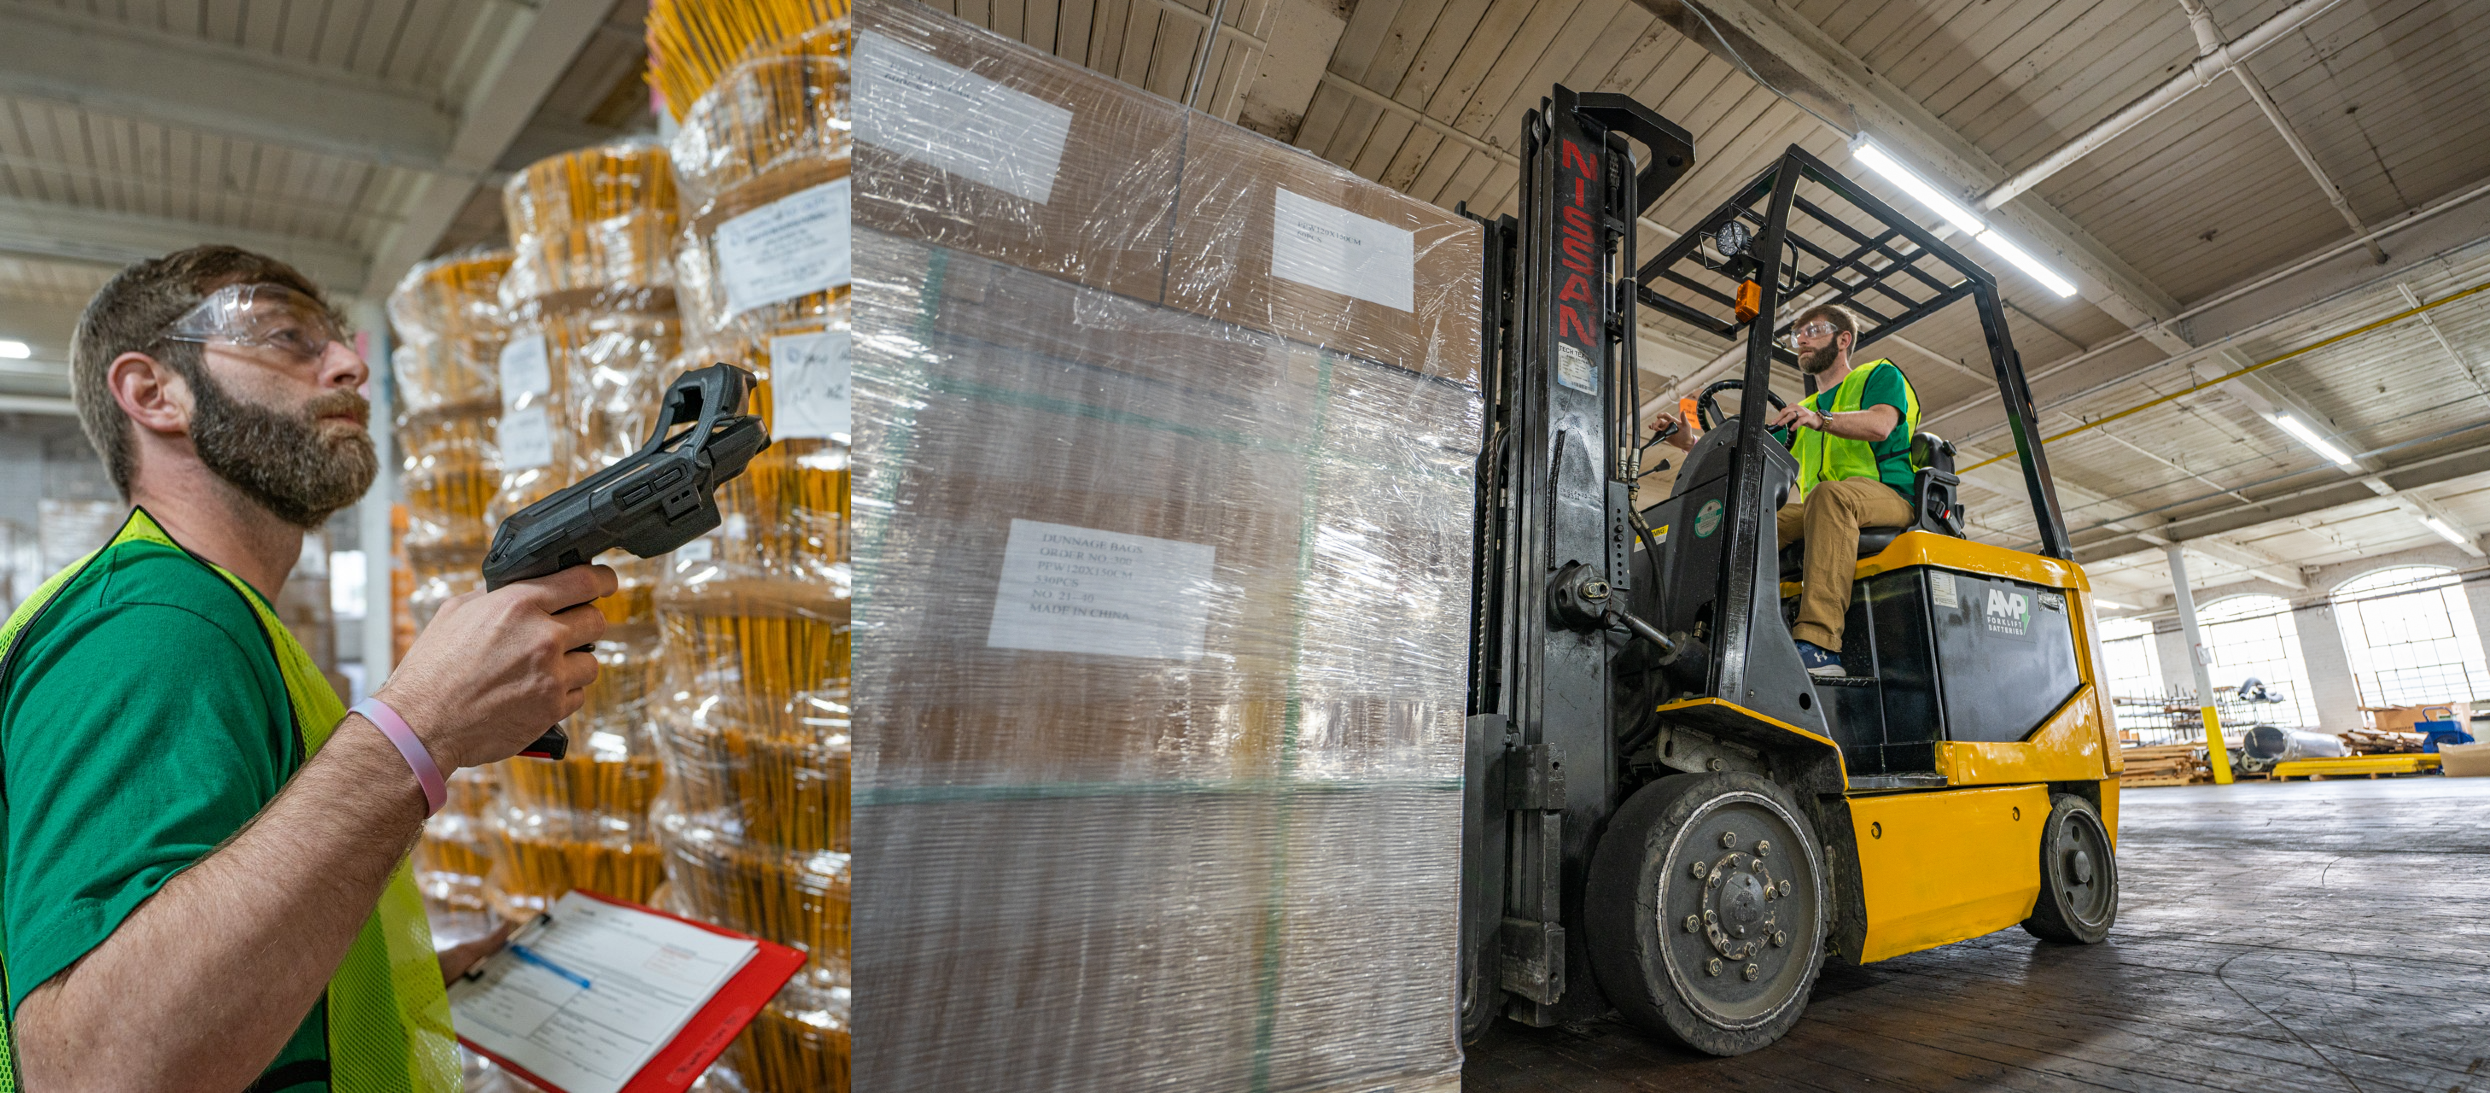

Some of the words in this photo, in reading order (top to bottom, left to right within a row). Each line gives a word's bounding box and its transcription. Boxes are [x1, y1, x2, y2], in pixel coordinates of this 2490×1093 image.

[1558, 138, 1598, 348] NISSAN
[1559, 345, 1574, 355] TECH
[1043, 533, 1107, 550] DUNNAGE
[1110, 542, 1143, 554] BAGS
[1040, 547, 1084, 560] ORDER
[1029, 603, 1070, 615] MADE
[1073, 606, 1087, 617] IN
[1089, 608, 1130, 620] CHINA
[1987, 588, 2027, 620] AMP
[1987, 616, 2022, 629] FORKLIFT
[1988, 624, 2024, 636] BATTERIES
